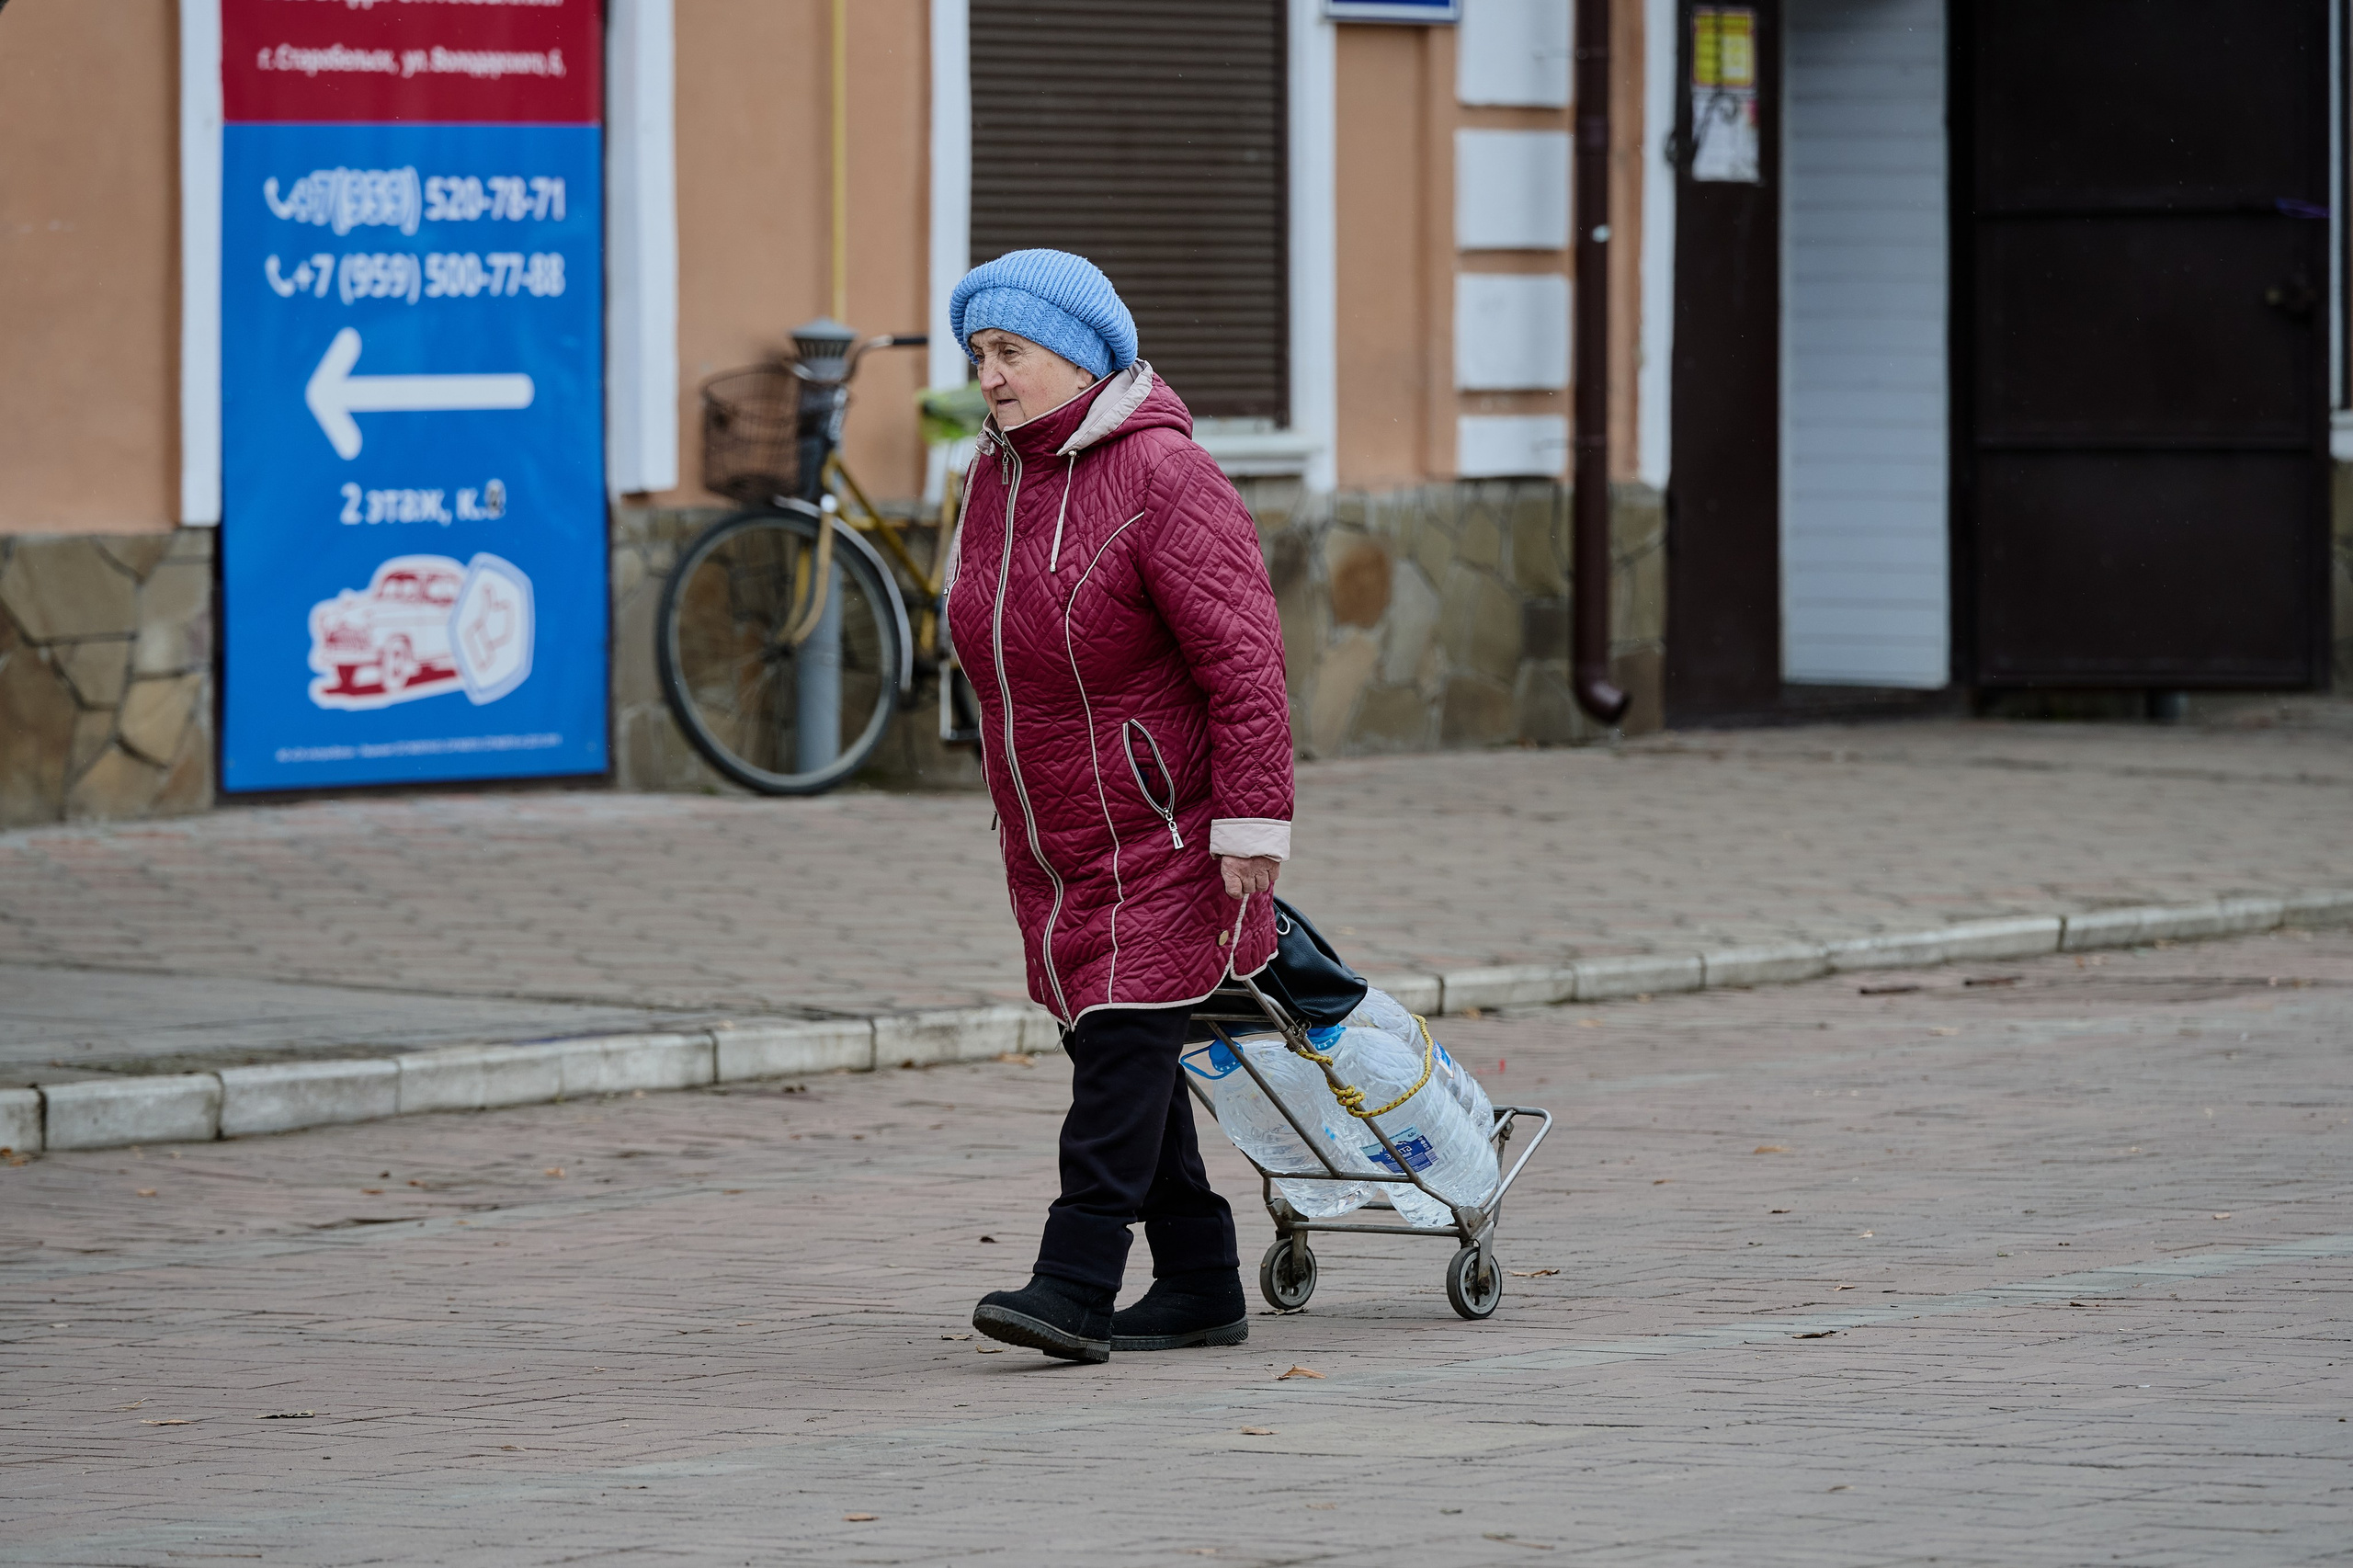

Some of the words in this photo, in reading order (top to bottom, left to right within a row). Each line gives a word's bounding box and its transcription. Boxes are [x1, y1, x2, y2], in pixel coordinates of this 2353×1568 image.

[425, 176, 566, 222] 520-78-71
[294, 253, 335, 298] +7
[338, 252, 422, 306] (959)
[425, 251, 566, 298] 500-77-88
[340, 482, 363, 525] 2
